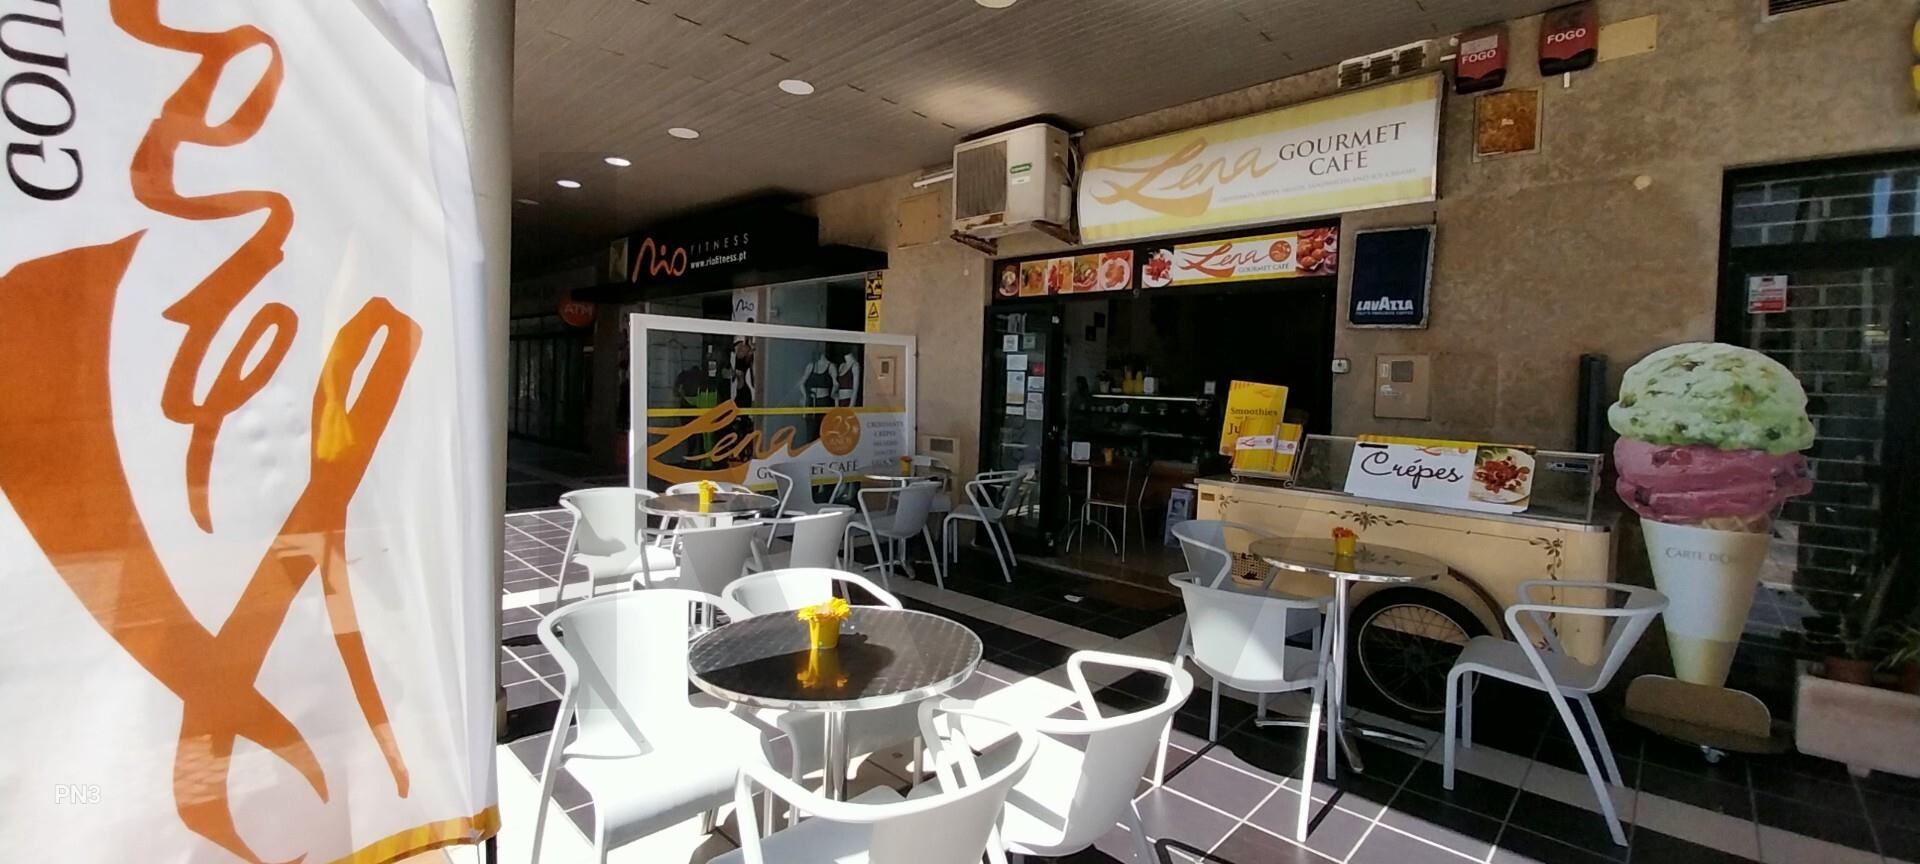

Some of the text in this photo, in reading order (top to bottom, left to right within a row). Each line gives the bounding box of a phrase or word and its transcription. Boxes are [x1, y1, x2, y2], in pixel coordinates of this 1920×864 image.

[1546, 28, 1586, 44] FOGO
[1461, 50, 1496, 64] FOGO
[1279, 121, 1406, 161] GOURMET
[1089, 137, 1279, 218] Lena
[690, 232, 749, 256] FITNESS
[690, 250, 747, 270] www.riofitness.pt
[1177, 242, 1270, 278] Lena
[1356, 296, 1413, 311] LAVAZZA
[1230, 407, 1278, 416] Smoothies
[647, 400, 823, 485] Lena
